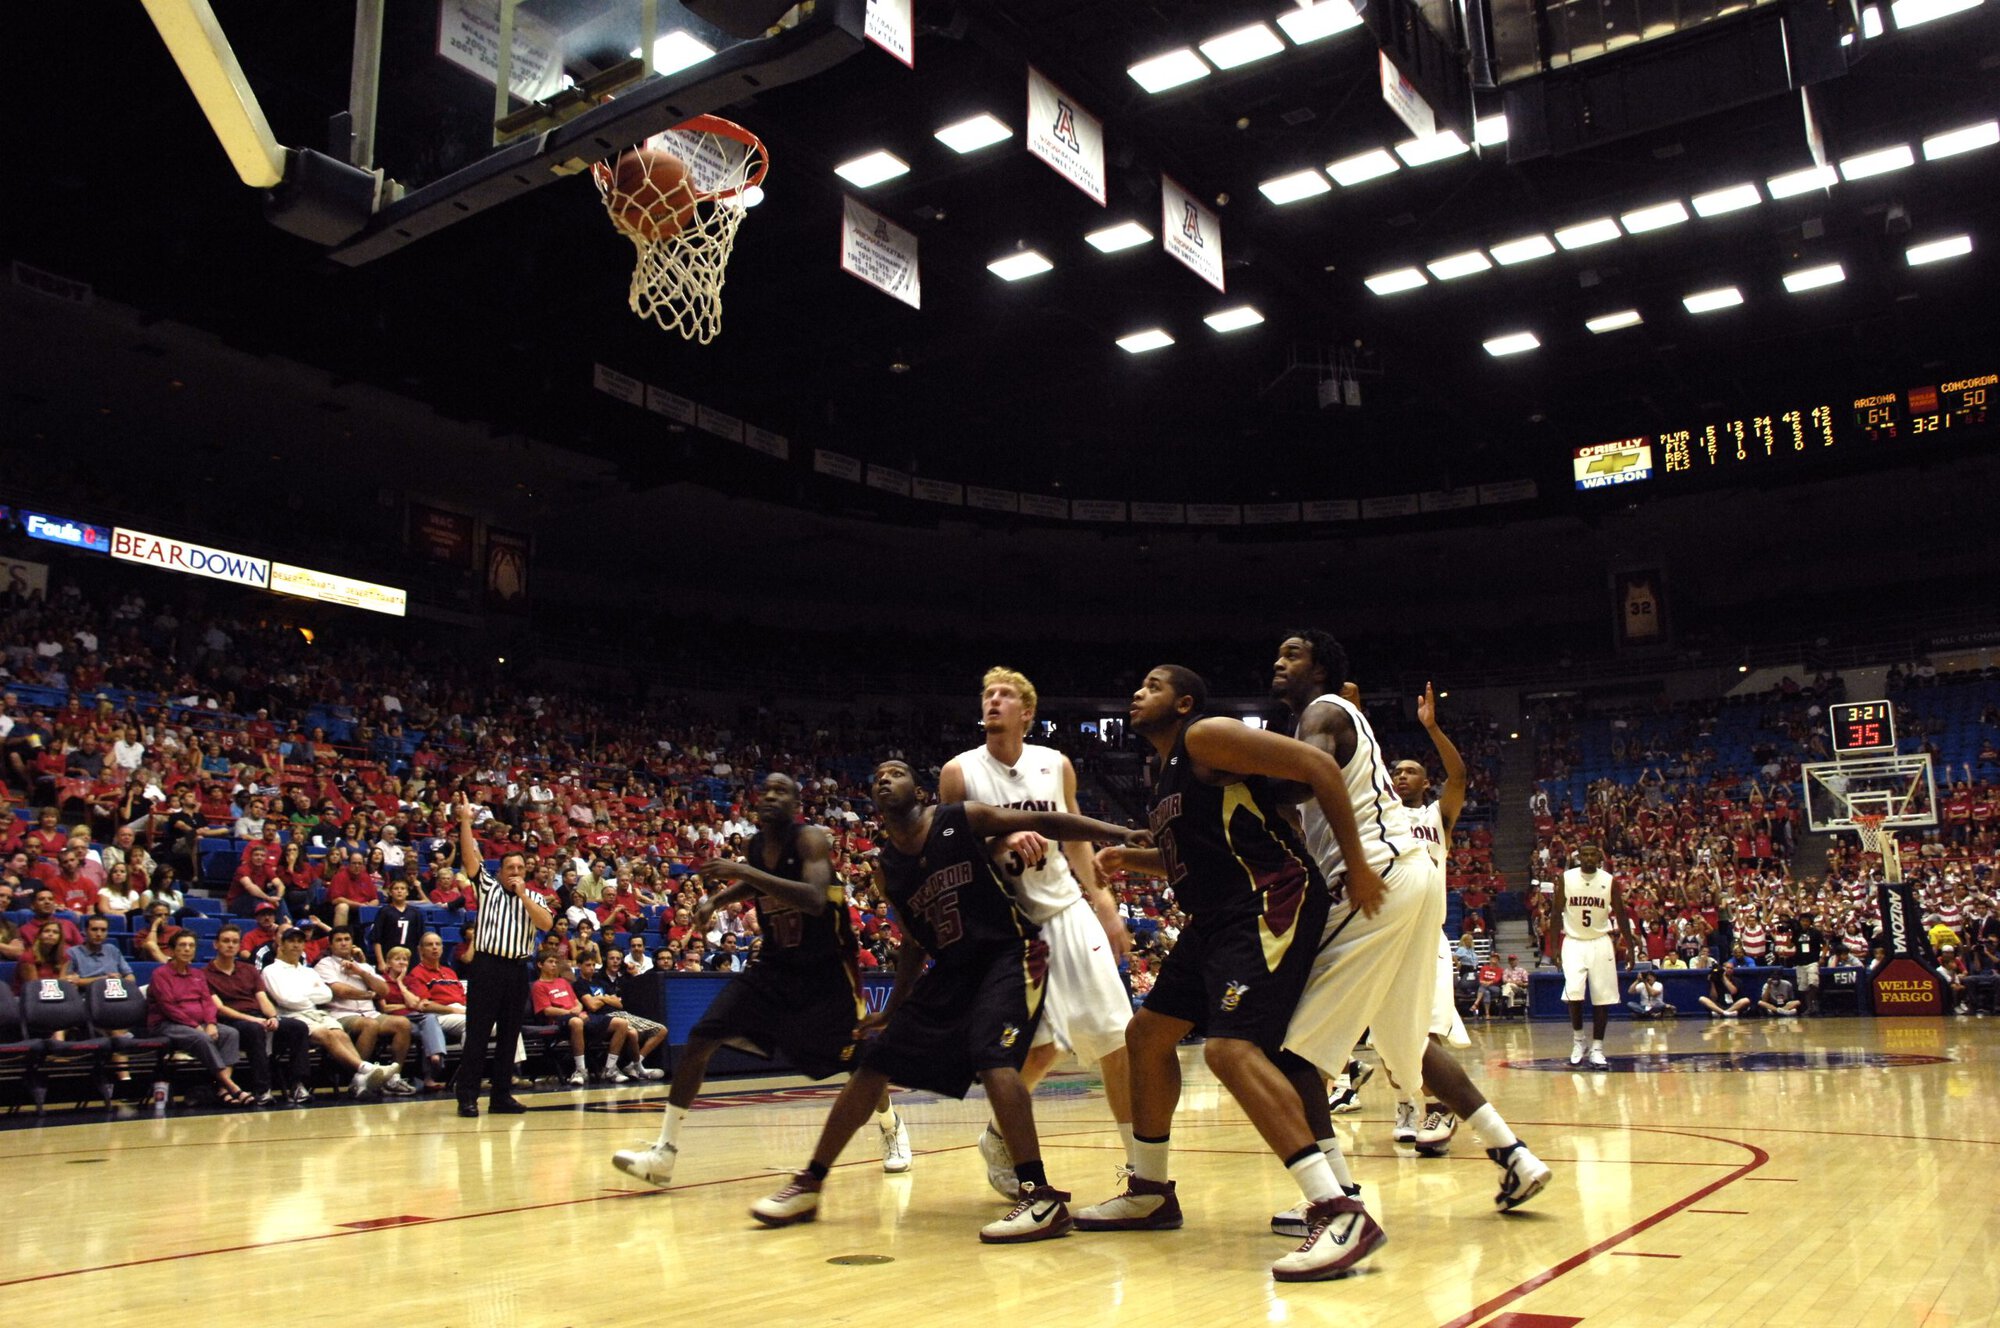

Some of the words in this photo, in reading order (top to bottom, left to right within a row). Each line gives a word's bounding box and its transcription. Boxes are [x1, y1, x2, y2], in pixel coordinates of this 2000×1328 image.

[1053, 99, 1079, 154] A
[1183, 200, 1203, 248] A
[1940, 374, 1998, 394] CONCORDIA
[1854, 393, 1896, 409] ARIZONA
[1963, 389, 1986, 407] 50
[1868, 406, 1890, 424] 64
[1912, 413, 1951, 434] 3:21
[1660, 430, 1689, 445] PLYR
[1706, 425, 1715, 436] 5
[1727, 421, 1743, 432] 13
[1754, 416, 1771, 428] 34
[1782, 411, 1800, 422] 42
[1812, 406, 1830, 418] 43
[1579, 438, 1642, 457] O'RIELLY
[1666, 441, 1687, 452] PTS
[1737, 450, 1746, 460] 0
[1794, 441, 1804, 451] 0
[1666, 450, 1689, 463] RBS
[1582, 470, 1647, 489] WATSON
[28, 515, 82, 541] Fouls
[1630, 601, 1651, 616] 32
[1848, 705, 1884, 721] 3:21
[1849, 723, 1880, 747] 35
[1569, 896, 1605, 909] ARIZONA
[1582, 910, 1592, 928] 5
[1887, 888, 1907, 954] ARIZONA
[397, 920, 409, 945] 7
[1834, 971, 1857, 984] FSN
[1878, 980, 1933, 991] WELLS
[40, 979, 64, 1000] A
[103, 978, 128, 999] A
[1881, 991, 1934, 1003] FARGO
